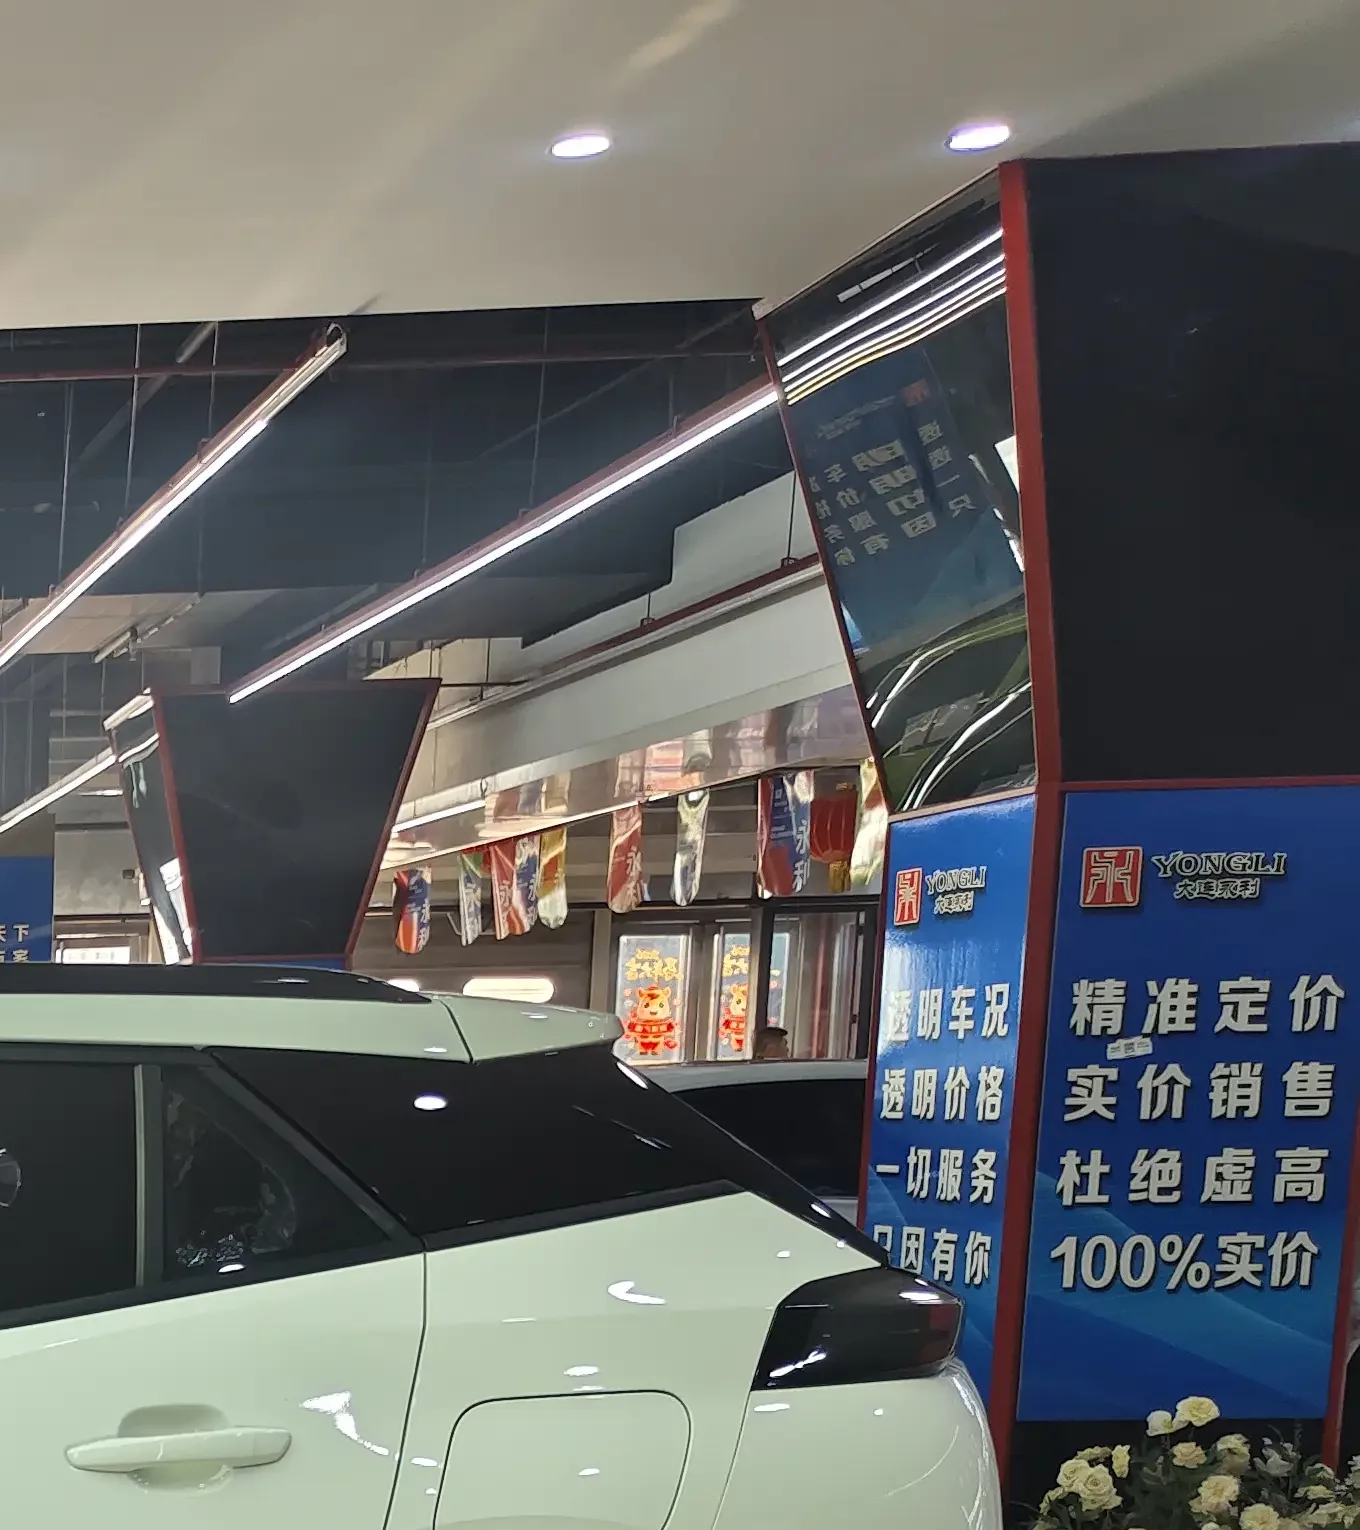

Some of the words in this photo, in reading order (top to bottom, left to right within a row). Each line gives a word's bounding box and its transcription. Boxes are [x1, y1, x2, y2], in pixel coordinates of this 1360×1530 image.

[925, 865, 988, 896] YONGLI
[1152, 851, 1288, 877] YONGLI
[1173, 878, 1261, 900] 大连永利
[887, 983, 1011, 1043] 透明车况
[1068, 973, 1345, 1037] 精准定价
[880, 1065, 1005, 1123] 透明价格
[1062, 1061, 1338, 1123] 实价销售
[875, 1146, 998, 1205] 一切服务
[1055, 1146, 1331, 1206] 杜绝虚高
[1049, 1230, 1319, 1293] 100%实价
